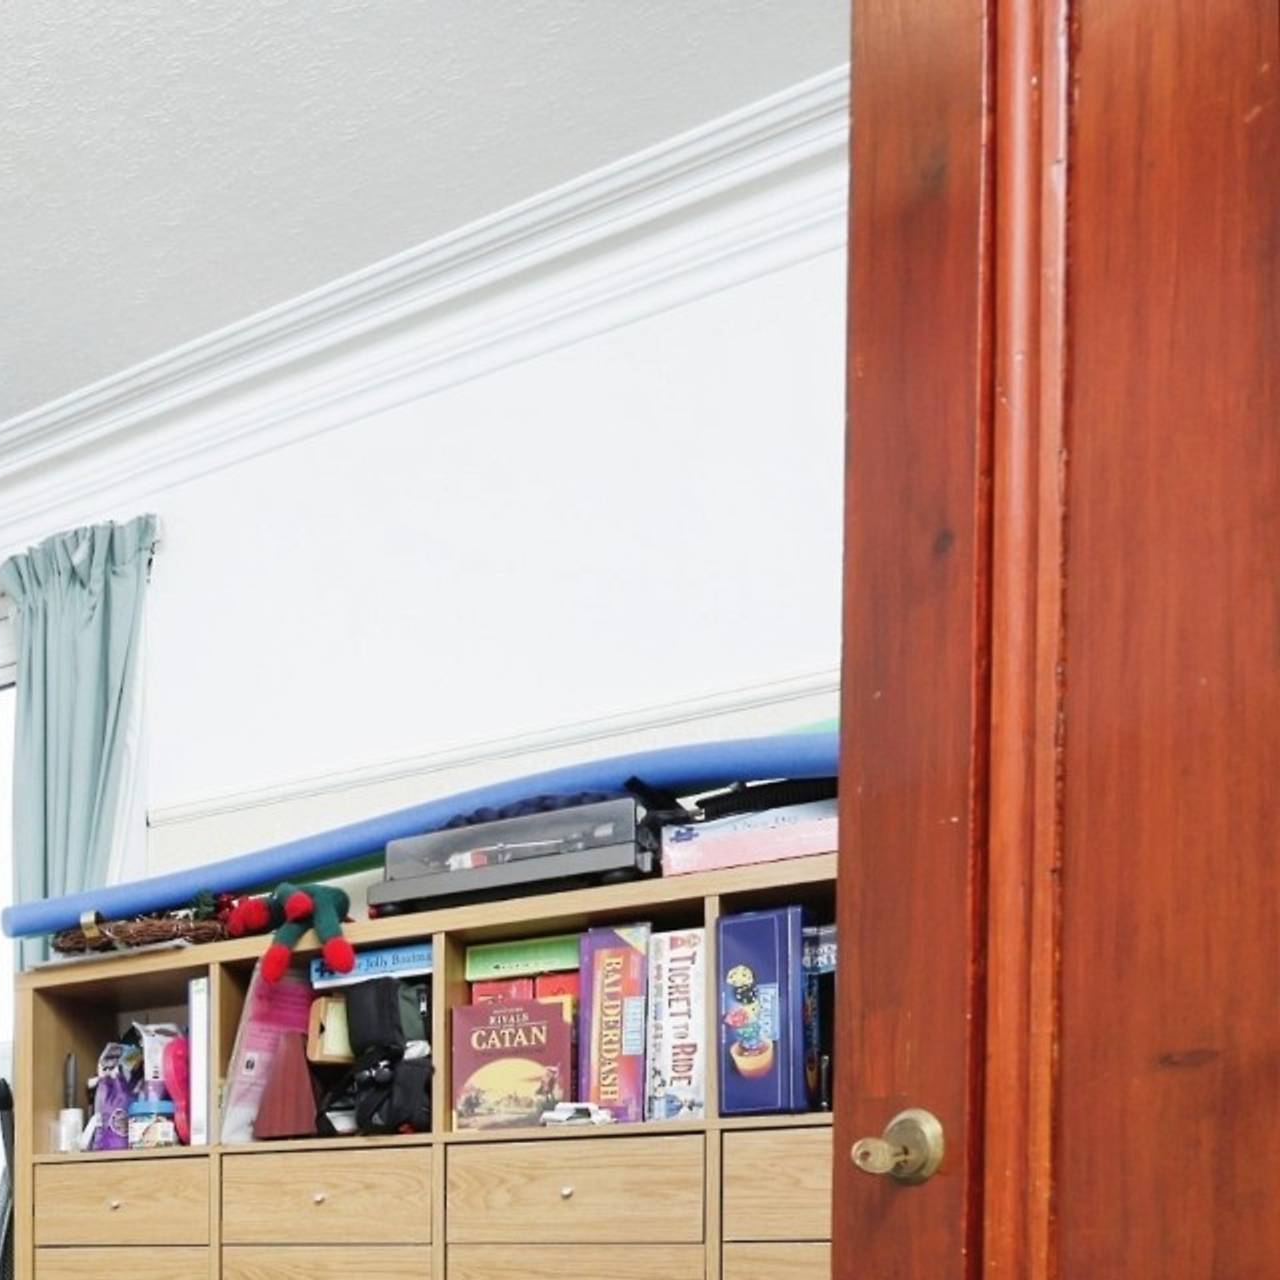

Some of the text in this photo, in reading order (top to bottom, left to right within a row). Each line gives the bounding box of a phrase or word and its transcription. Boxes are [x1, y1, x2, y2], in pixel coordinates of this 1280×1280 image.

[667, 952, 697, 1019] TICKET
[470, 1025, 547, 1051] CATAN
[599, 955, 624, 1102] BALDERDASH
[669, 1042, 698, 1087] RIDE
